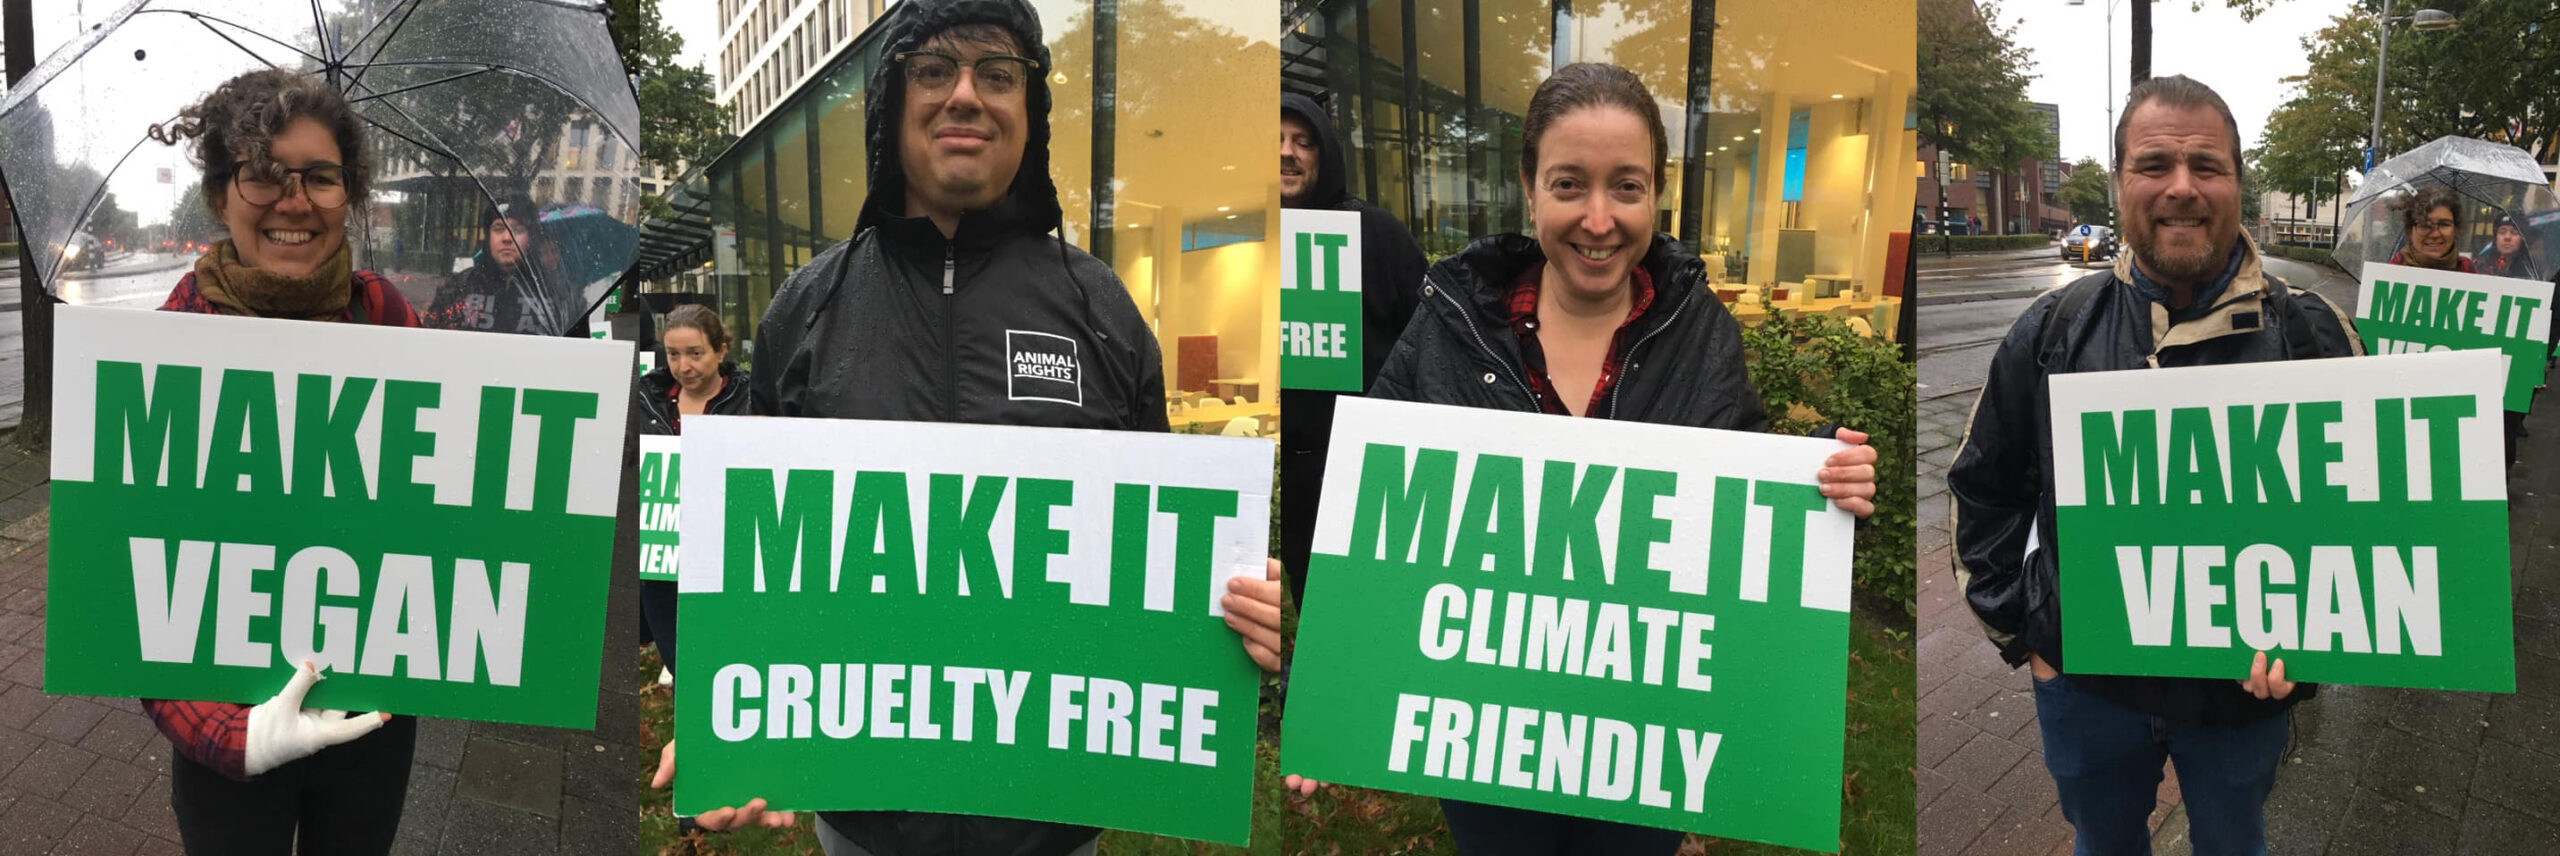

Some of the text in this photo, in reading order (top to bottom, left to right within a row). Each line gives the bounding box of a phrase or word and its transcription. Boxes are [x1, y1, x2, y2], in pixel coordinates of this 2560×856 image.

[1295, 232, 1348, 291] IT
[2369, 280, 2542, 340] MAKE IT
[1013, 350, 1076, 368] ANIMAL
[1017, 363, 1072, 380] RIGHTS
[93, 360, 599, 515] MAKE IT
[2080, 394, 2477, 506] MAKE IT
[722, 467, 1239, 616] MAKE IT
[1348, 442, 1828, 608] MAKE IT
[129, 536, 530, 687] VEGAN
[1418, 583, 1715, 692] CLIMATE
[2114, 543, 2442, 656] VEGAN
[711, 663, 1219, 766] CRUELTY FREE
[1388, 693, 1722, 813] FRIENDLY
